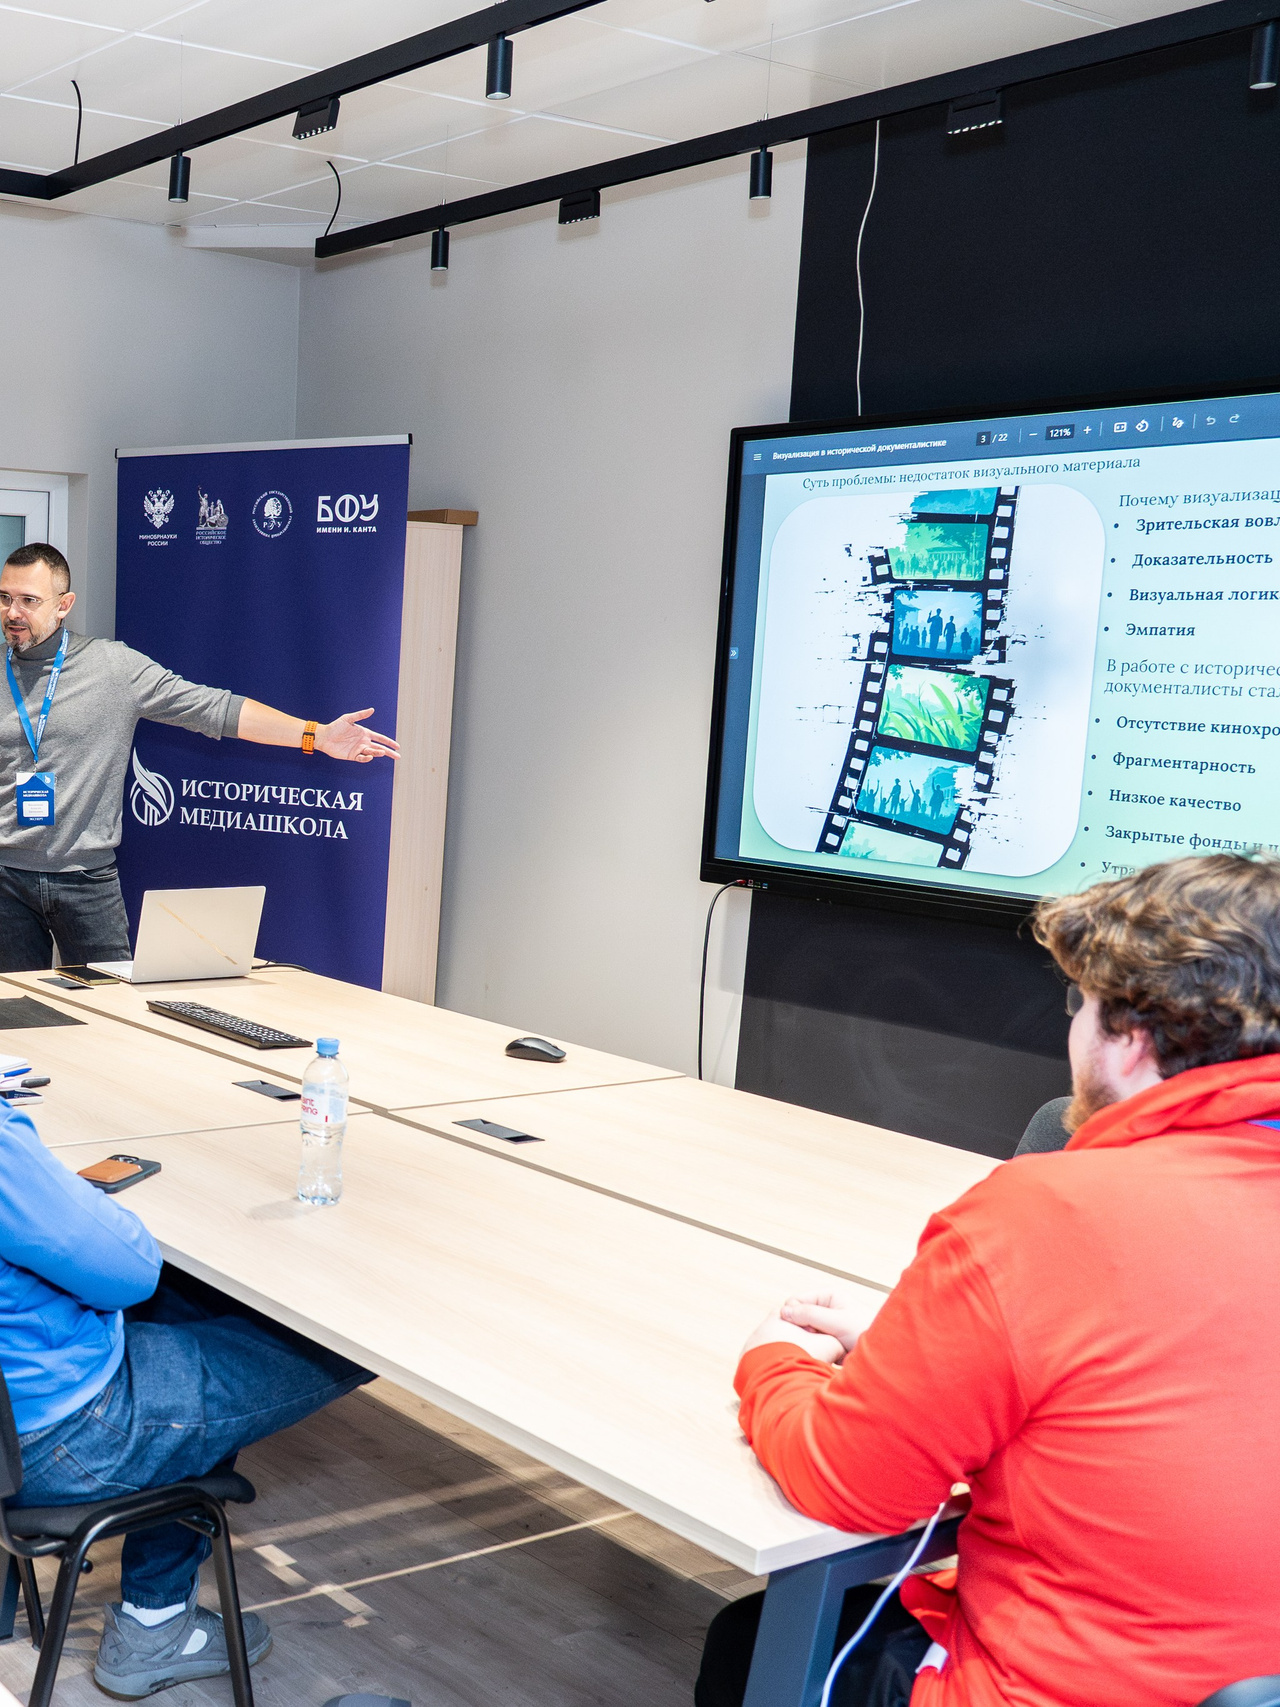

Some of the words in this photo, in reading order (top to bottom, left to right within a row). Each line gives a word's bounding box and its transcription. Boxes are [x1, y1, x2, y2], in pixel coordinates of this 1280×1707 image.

[980, 435, 986, 444] 3
[998, 433, 1008, 442] 22
[1049, 427, 1071, 438] 121%
[772, 450, 820, 461] Визуализация
[826, 444, 876, 457] исторической
[876, 439, 947, 453] документалистике
[802, 477, 830, 491] Суть
[832, 474, 896, 489] проблемы:
[899, 469, 970, 483] недостаток
[973, 463, 1059, 480] визуального
[1062, 457, 1141, 473] материала
[317, 494, 379, 523] БФУ
[1119, 494, 1179, 508] Почему
[1135, 518, 1240, 535] Зрительская
[1131, 553, 1273, 569] Доказательность
[1129, 588, 1224, 605] Визуальная
[1227, 590, 1280, 601] логик
[1125, 623, 1196, 636] Эмпатия
[1106, 658, 1116, 672] В
[1120, 659, 1175, 676] работе
[1180, 663, 1189, 674] с
[1103, 682, 1243, 698] документалисты
[1116, 716, 1206, 733] Отсутствие
[1112, 752, 1256, 774] Фрагментарность
[181, 779, 363, 811] ИСТОРИЧЕСКАЯ
[1109, 789, 1165, 806] Низкое
[1169, 796, 1242, 812] качество
[180, 807, 349, 840] МЕДИАШКОЛА
[1105, 825, 1185, 845] Закрытые
[1189, 833, 1248, 852] фонды
